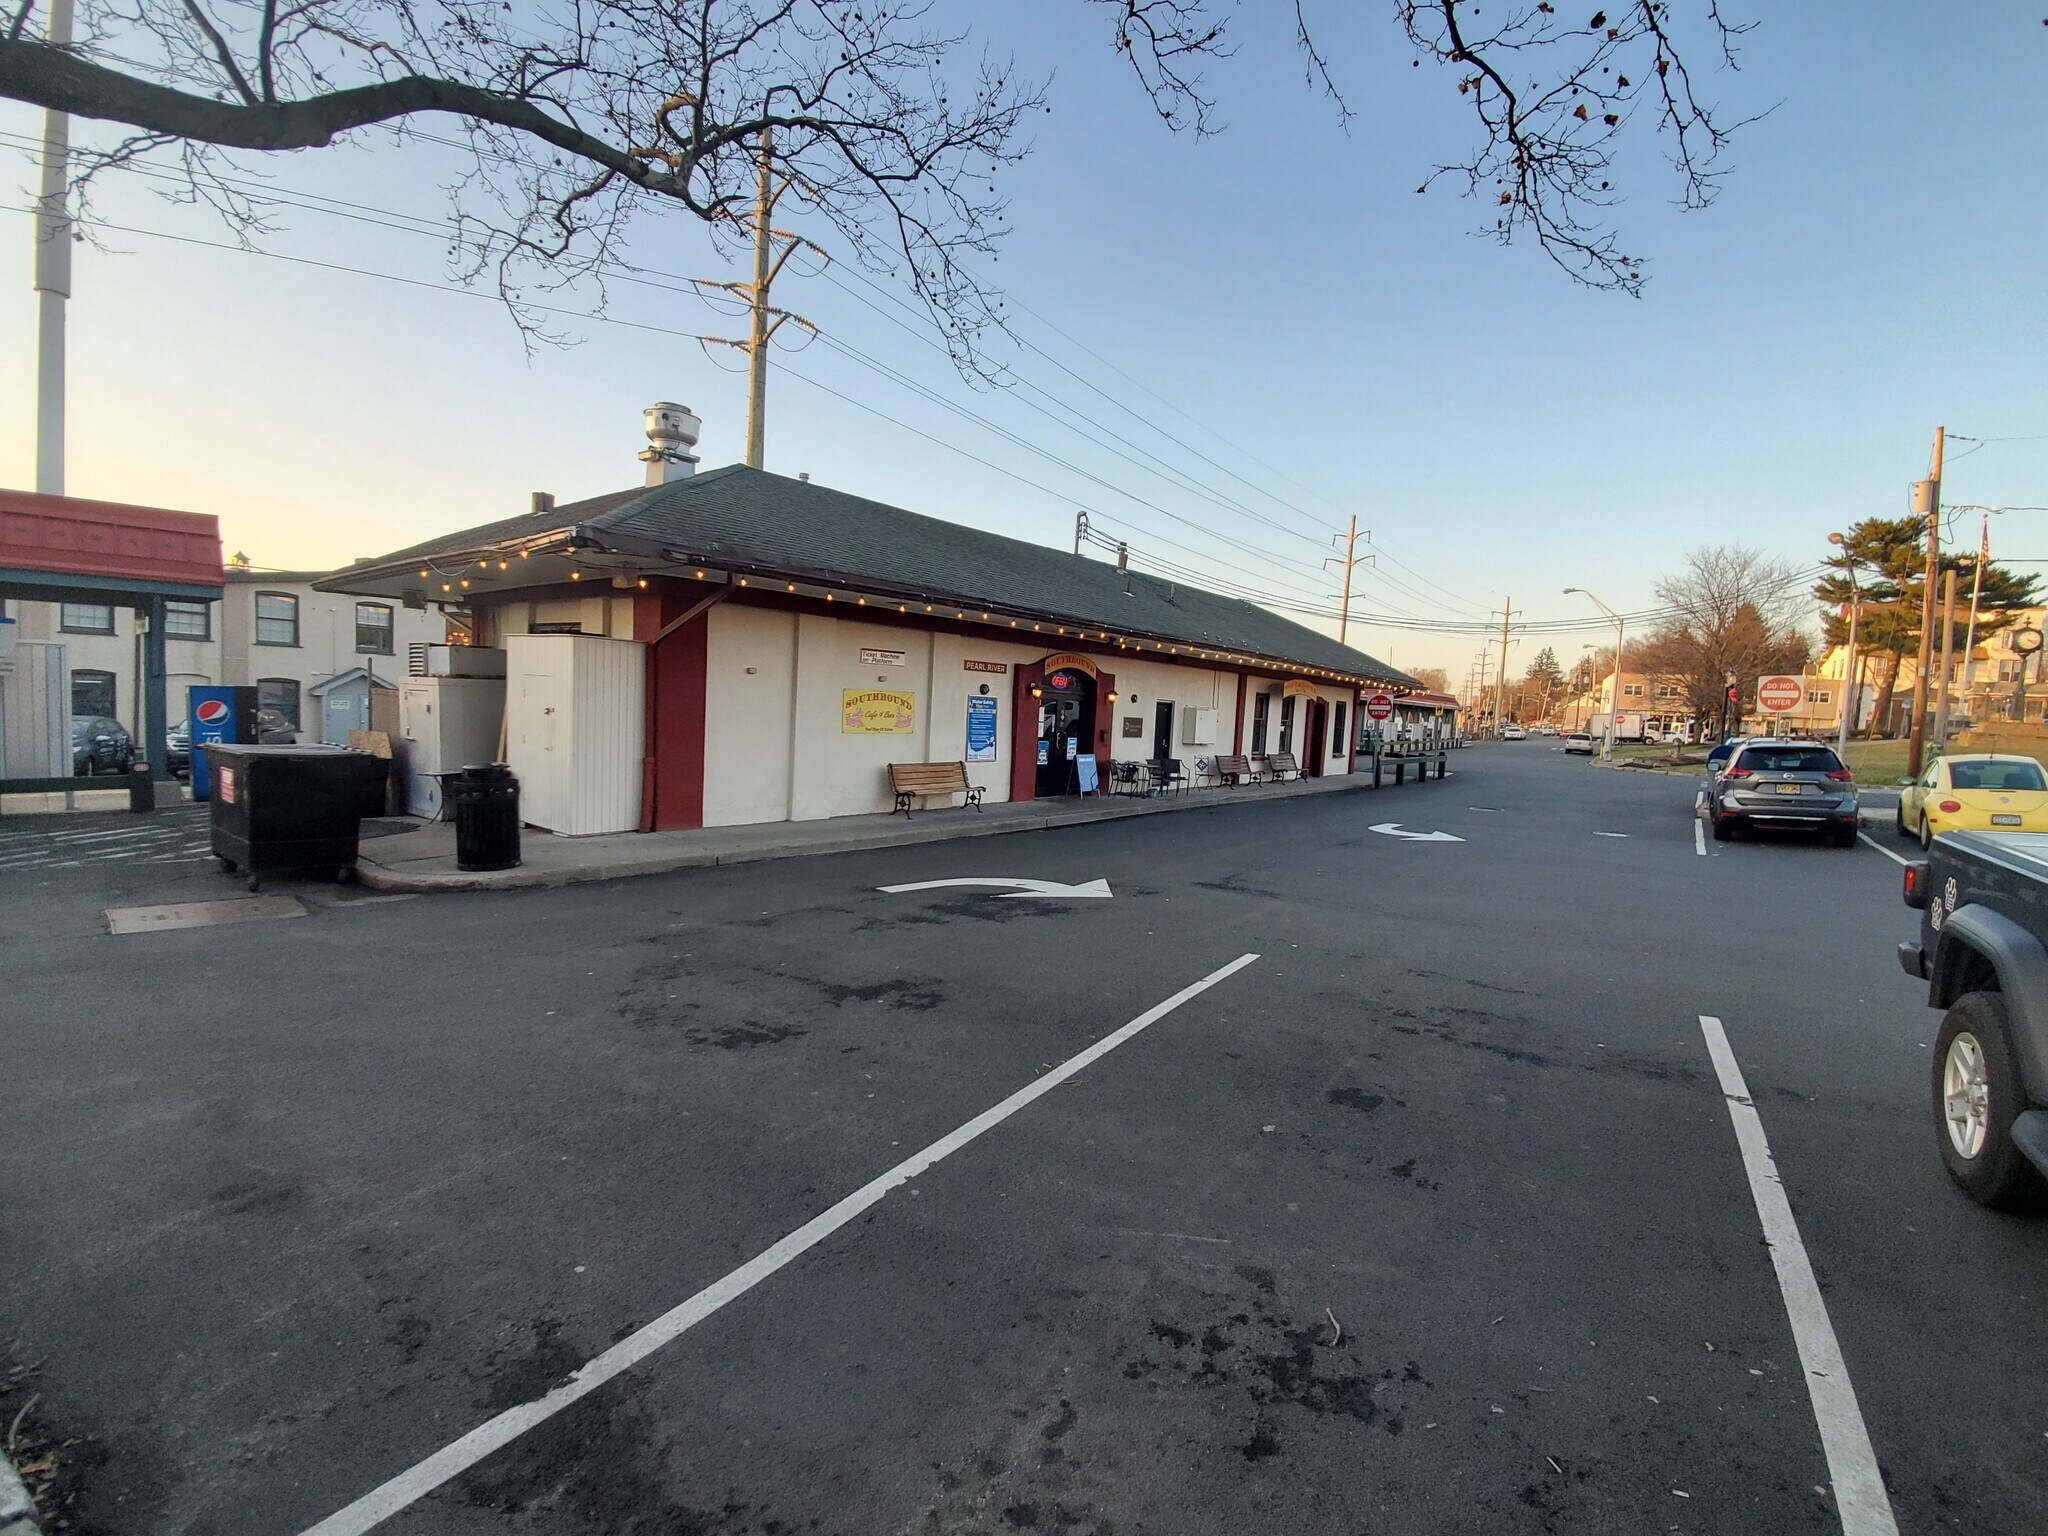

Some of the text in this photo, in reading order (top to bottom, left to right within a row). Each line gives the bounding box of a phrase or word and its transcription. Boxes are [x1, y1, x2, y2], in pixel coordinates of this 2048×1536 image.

[966, 662, 1005, 673] PEARL RIVER
[1046, 656, 1095, 673] SOUTHBOUND
[845, 693, 912, 710] SOUTHBOUND
